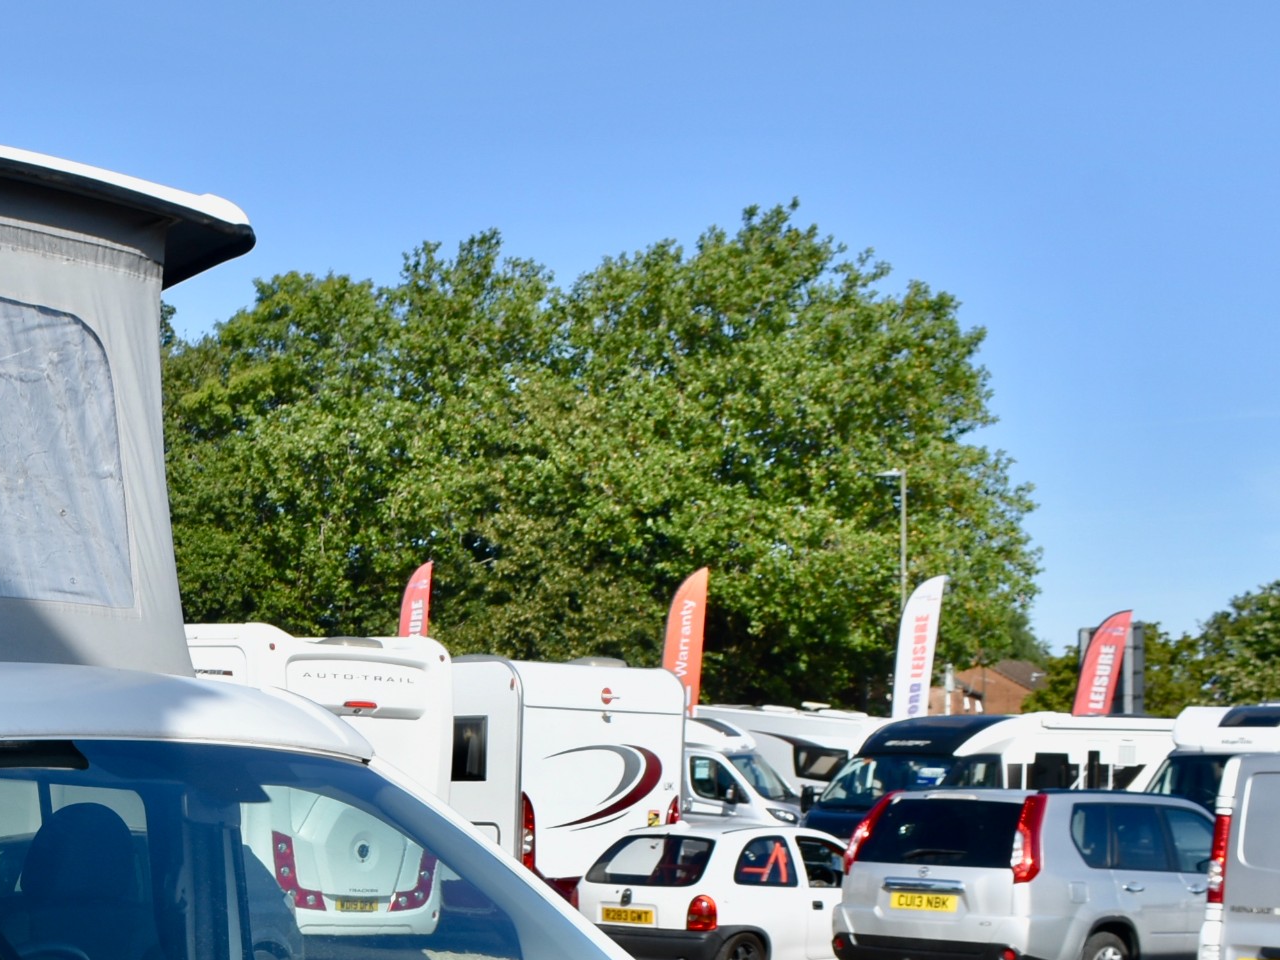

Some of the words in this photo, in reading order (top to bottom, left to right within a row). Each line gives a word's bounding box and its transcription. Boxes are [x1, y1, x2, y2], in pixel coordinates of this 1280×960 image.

[409, 599, 423, 637] URE
[675, 600, 696, 677] Warranty
[910, 614, 930, 678] LEISURE
[302, 671, 415, 685] AUTO-TRAIL
[1088, 645, 1116, 709] LEISURE
[907, 683, 922, 718] ORD
[897, 894, 923, 907] CU13
[926, 896, 949, 909] NBK
